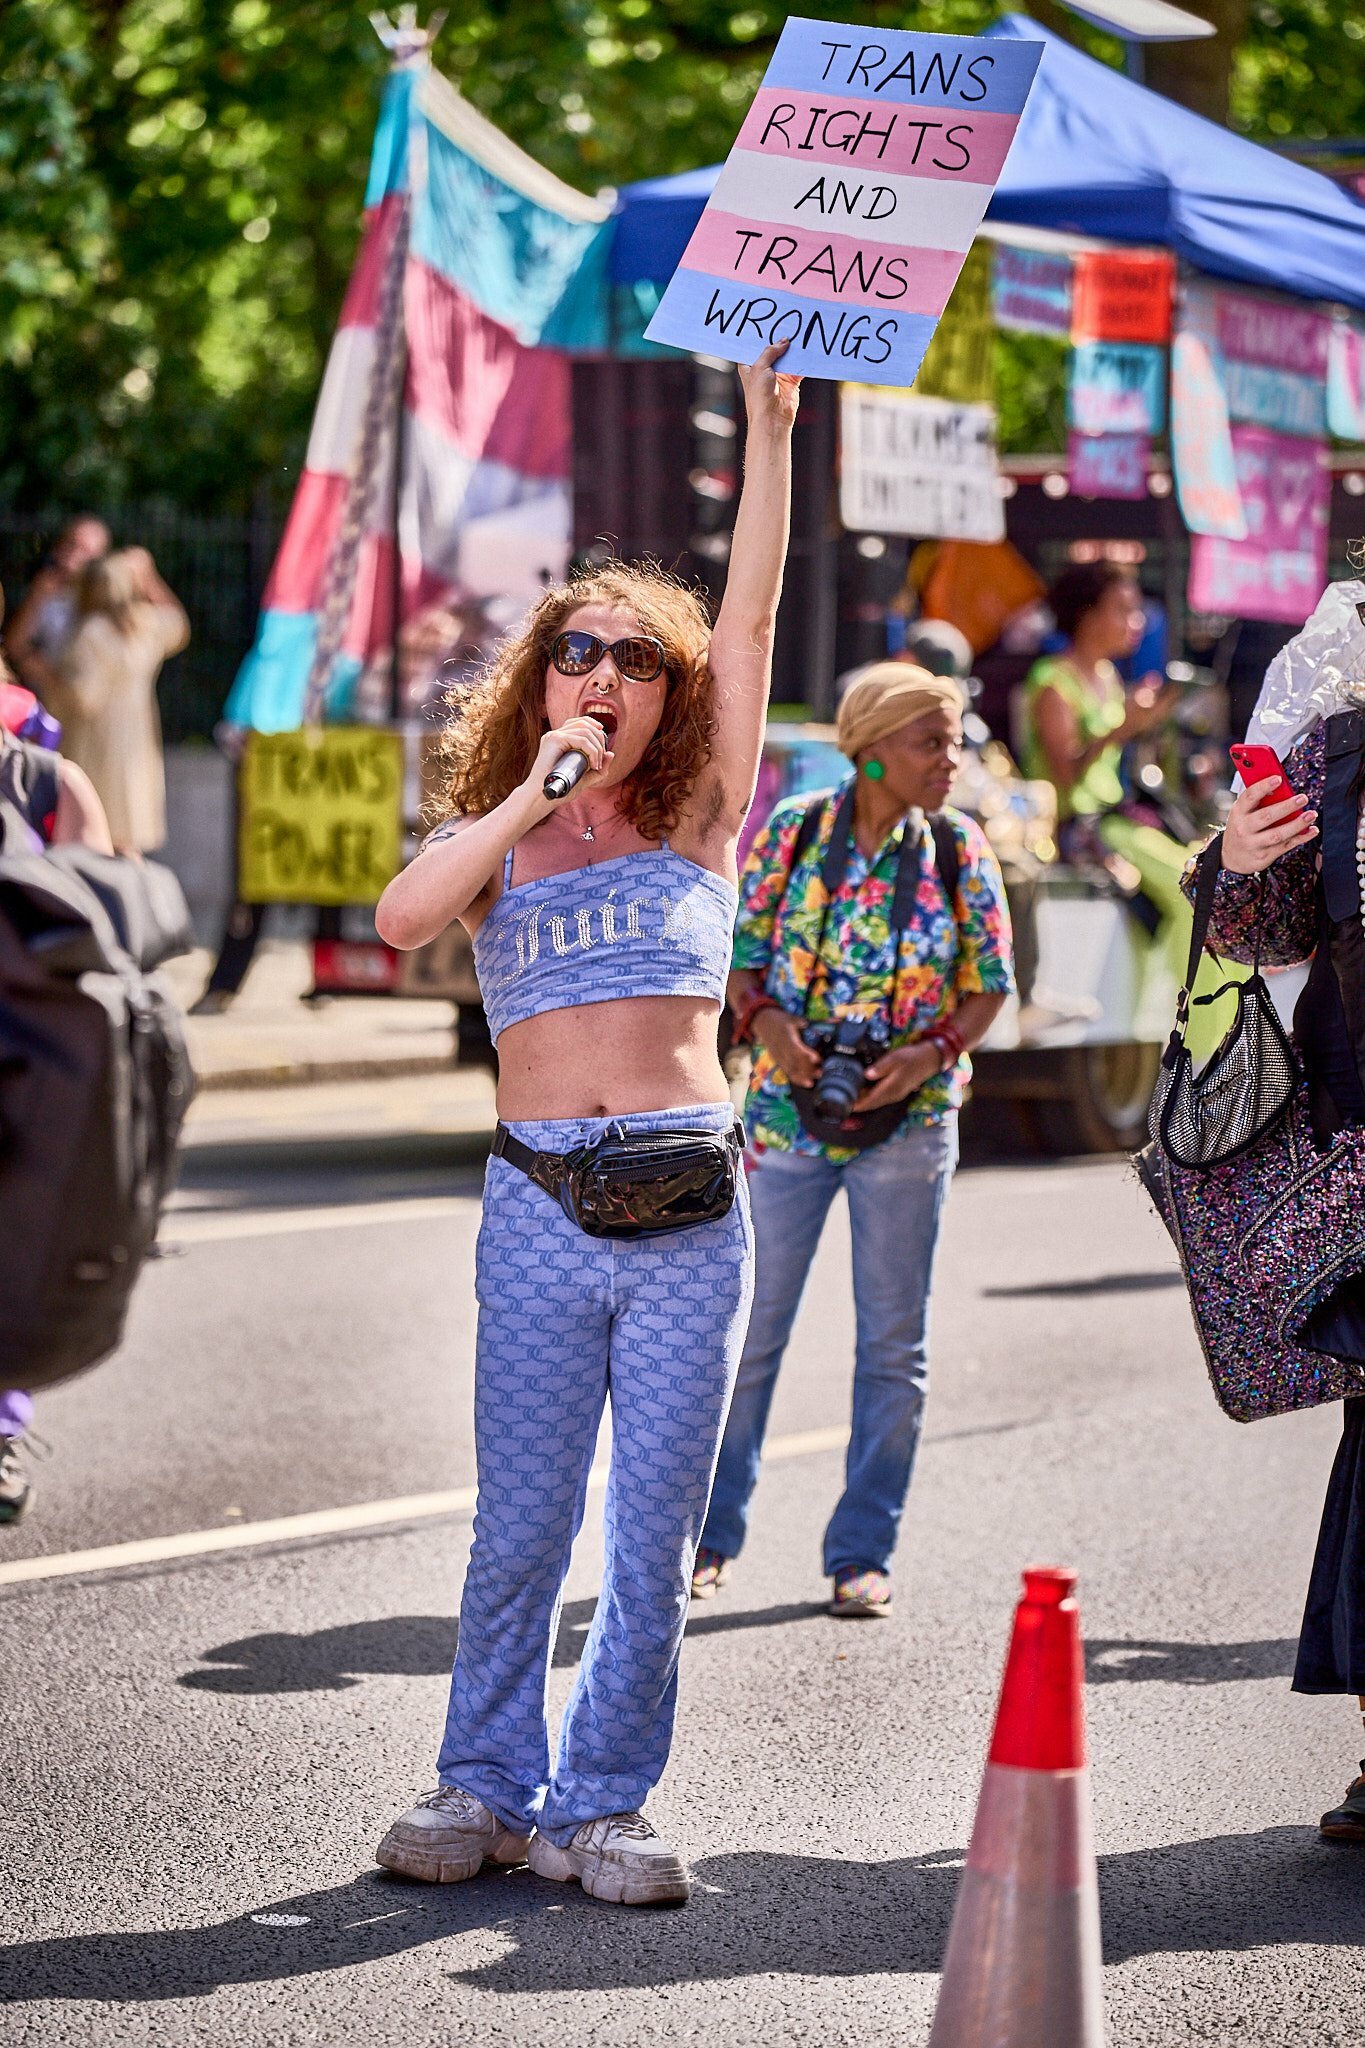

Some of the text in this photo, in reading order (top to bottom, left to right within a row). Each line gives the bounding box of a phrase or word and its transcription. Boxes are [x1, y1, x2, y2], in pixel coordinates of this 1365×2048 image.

[820, 41, 995, 102] TRANS
[760, 103, 974, 171] RIGHTS
[794, 176, 898, 220] AND
[734, 229, 909, 300] TRANS
[704, 288, 899, 364] WRONGS
[253, 741, 391, 804] TRANS
[250, 808, 391, 890] POWER
